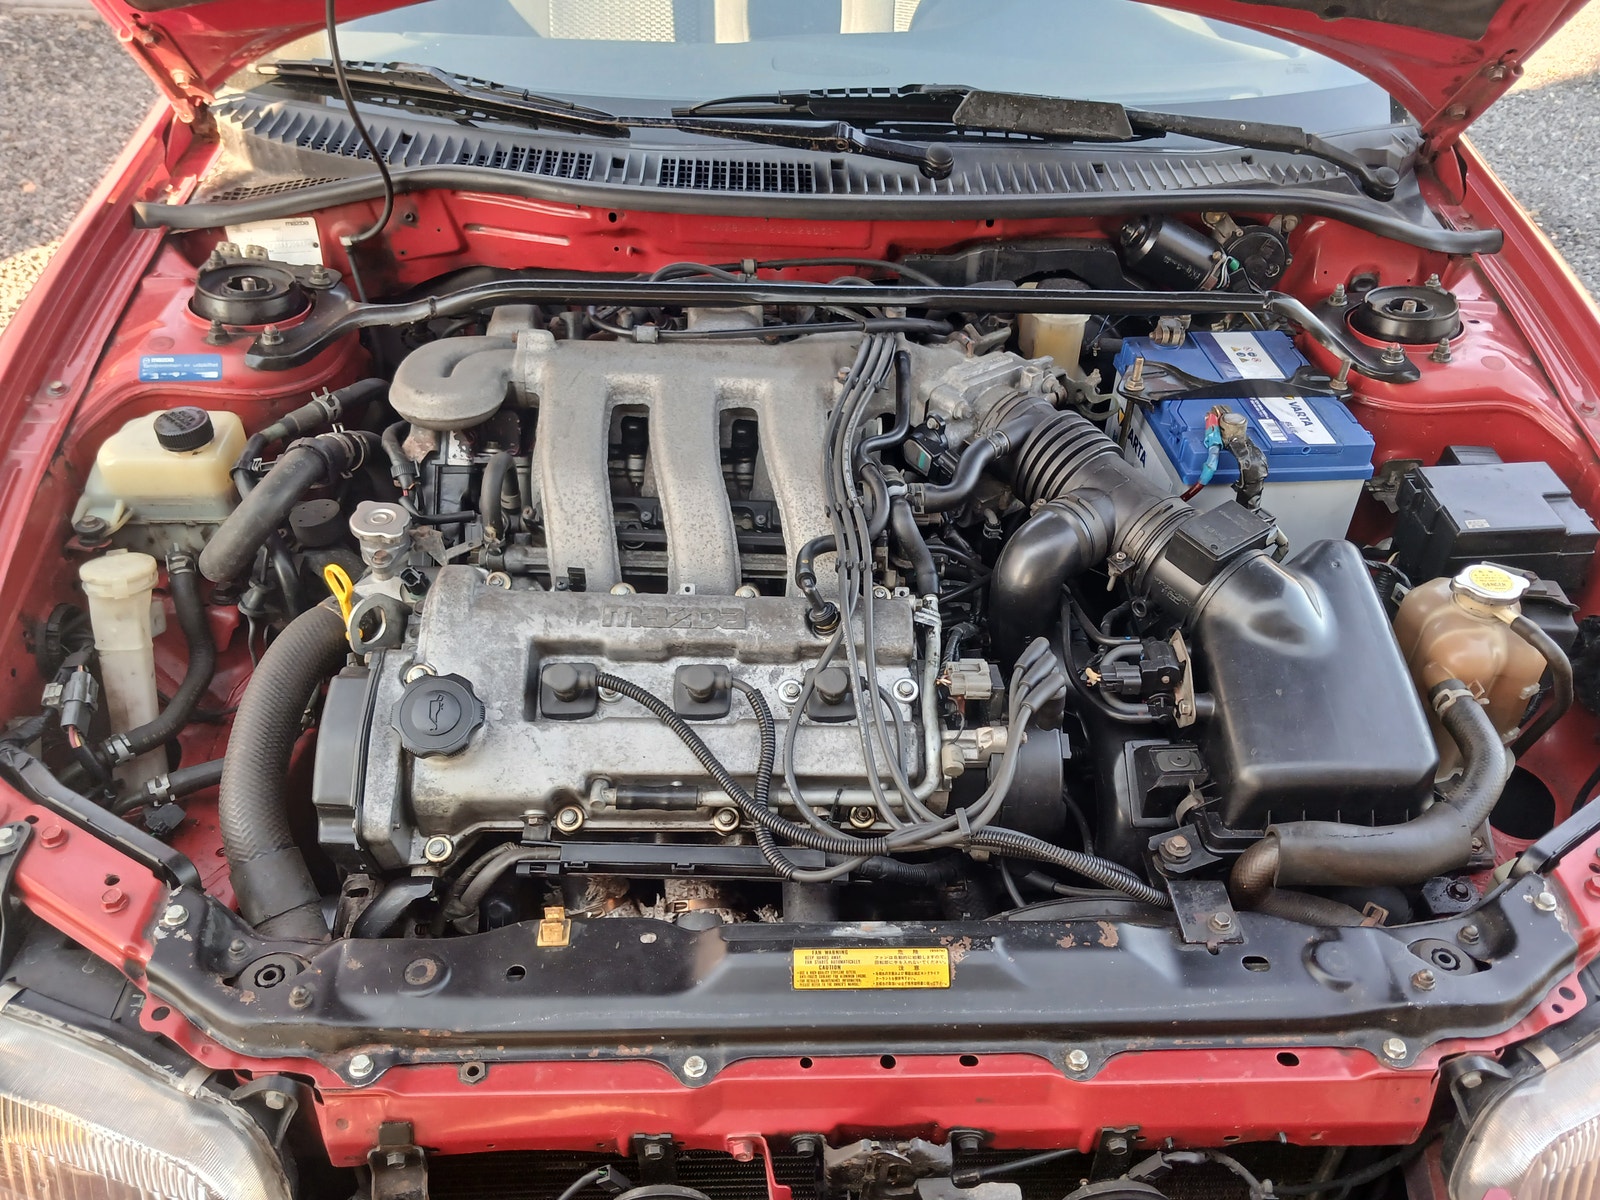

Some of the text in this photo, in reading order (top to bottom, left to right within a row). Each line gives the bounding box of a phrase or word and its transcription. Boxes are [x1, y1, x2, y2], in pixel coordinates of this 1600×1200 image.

[1288, 401, 1314, 427] VARTA
[1127, 427, 1146, 468] ARTA
[602, 605, 746, 629] mazda
